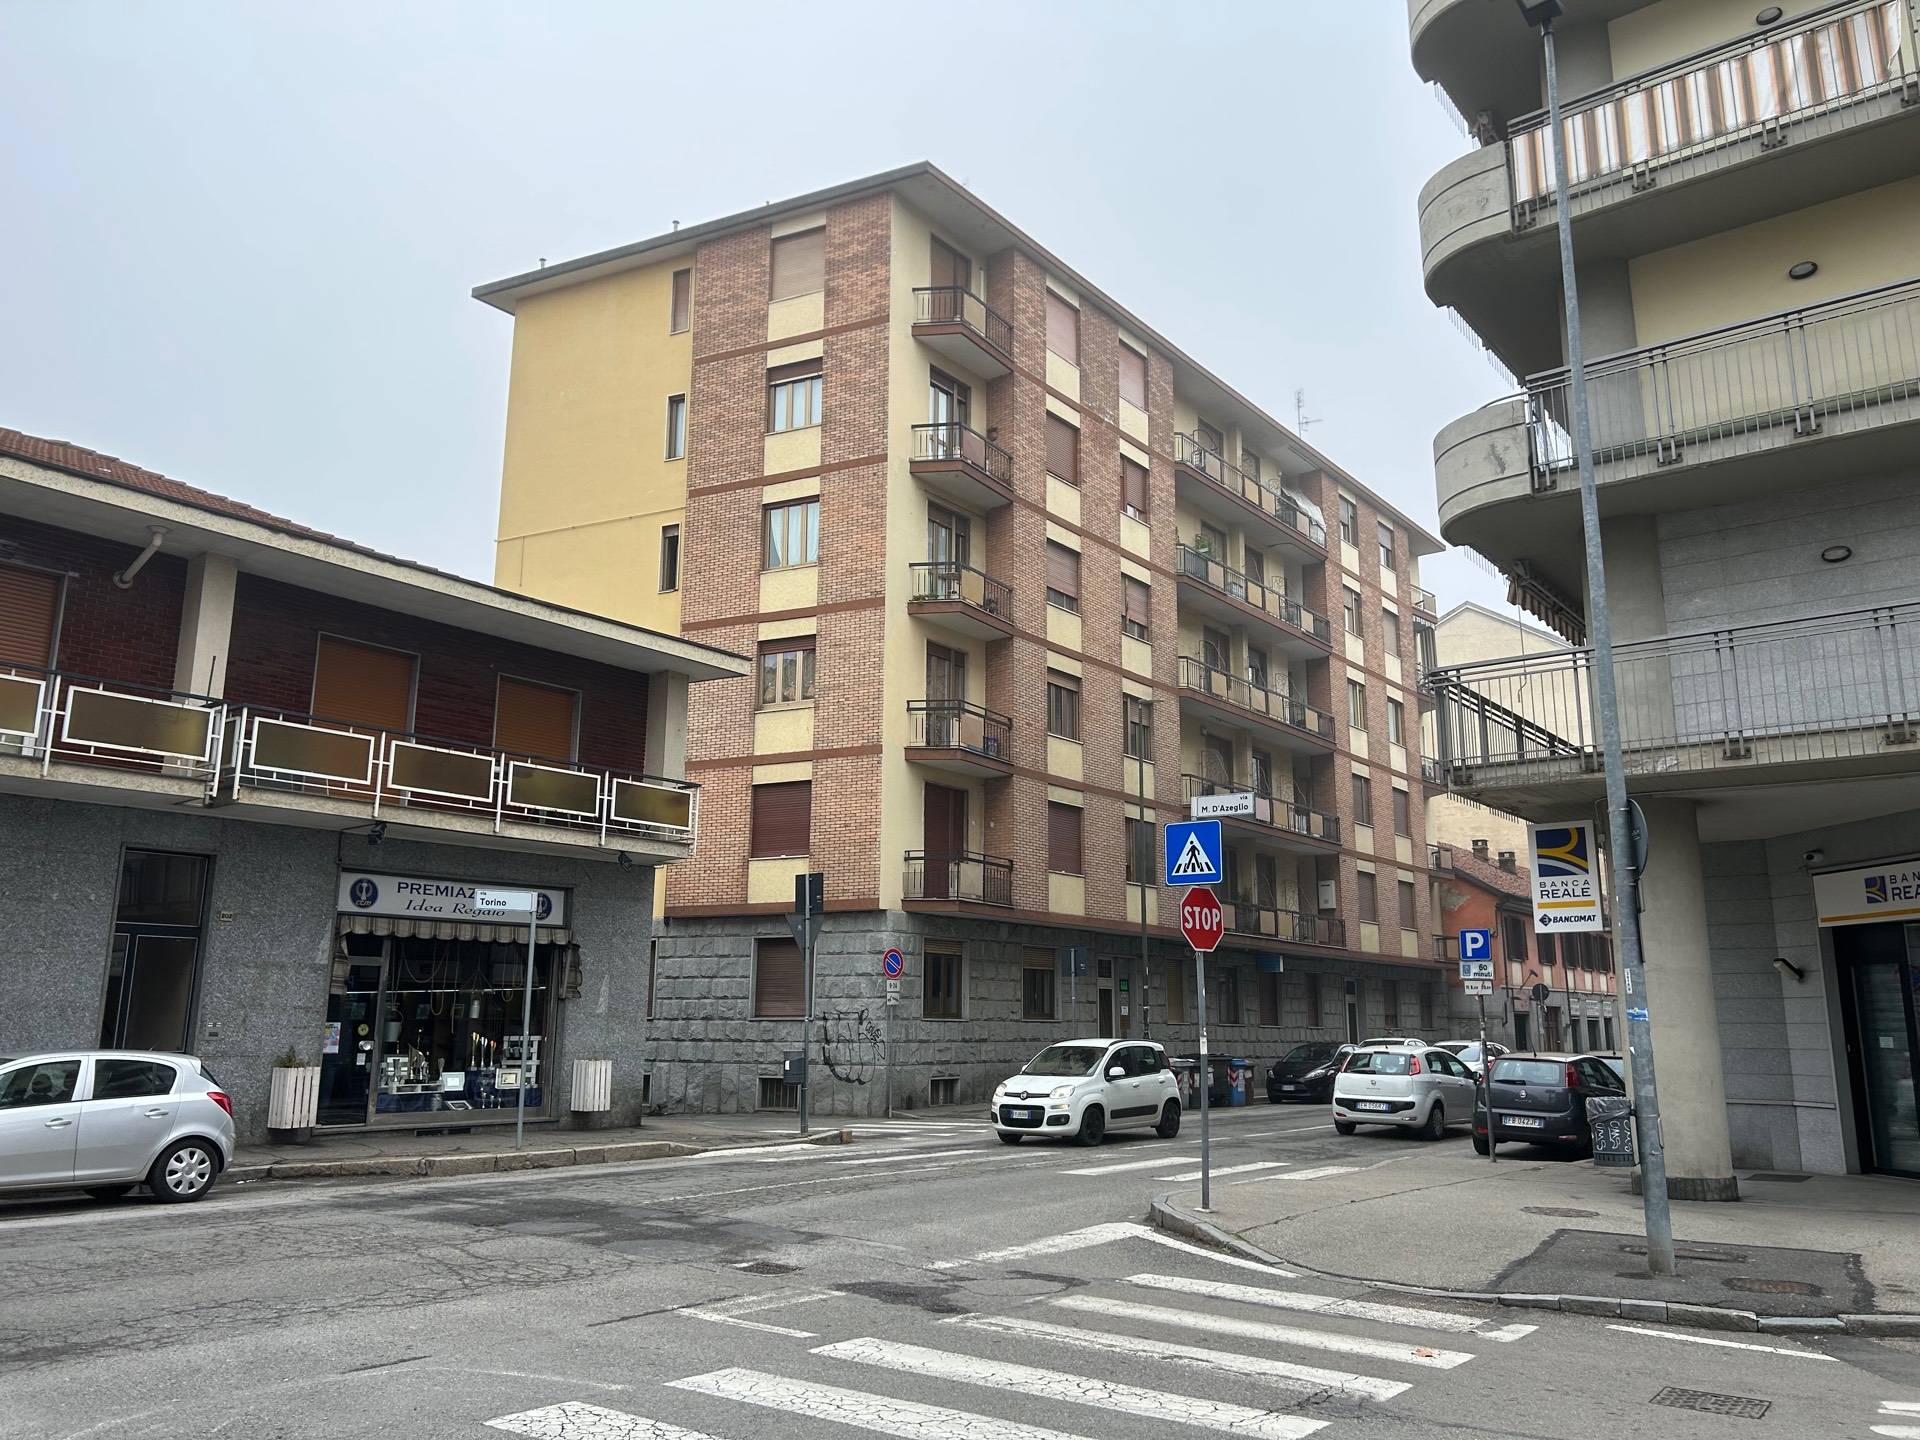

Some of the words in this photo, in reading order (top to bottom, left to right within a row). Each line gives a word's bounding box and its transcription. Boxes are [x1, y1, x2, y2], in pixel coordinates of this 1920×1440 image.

[1213, 803, 1249, 812] D'Azeglio
[1539, 879, 1590, 889] BANCA
[397, 882, 475, 899] PREMIAZ
[1540, 887, 1591, 899] REALE
[405, 899, 443, 912] Idea
[480, 898, 507, 906] Torino
[1184, 905, 1221, 931] STOP
[1553, 915, 1596, 923] BANCOMAT
[1465, 932, 1484, 957] P
